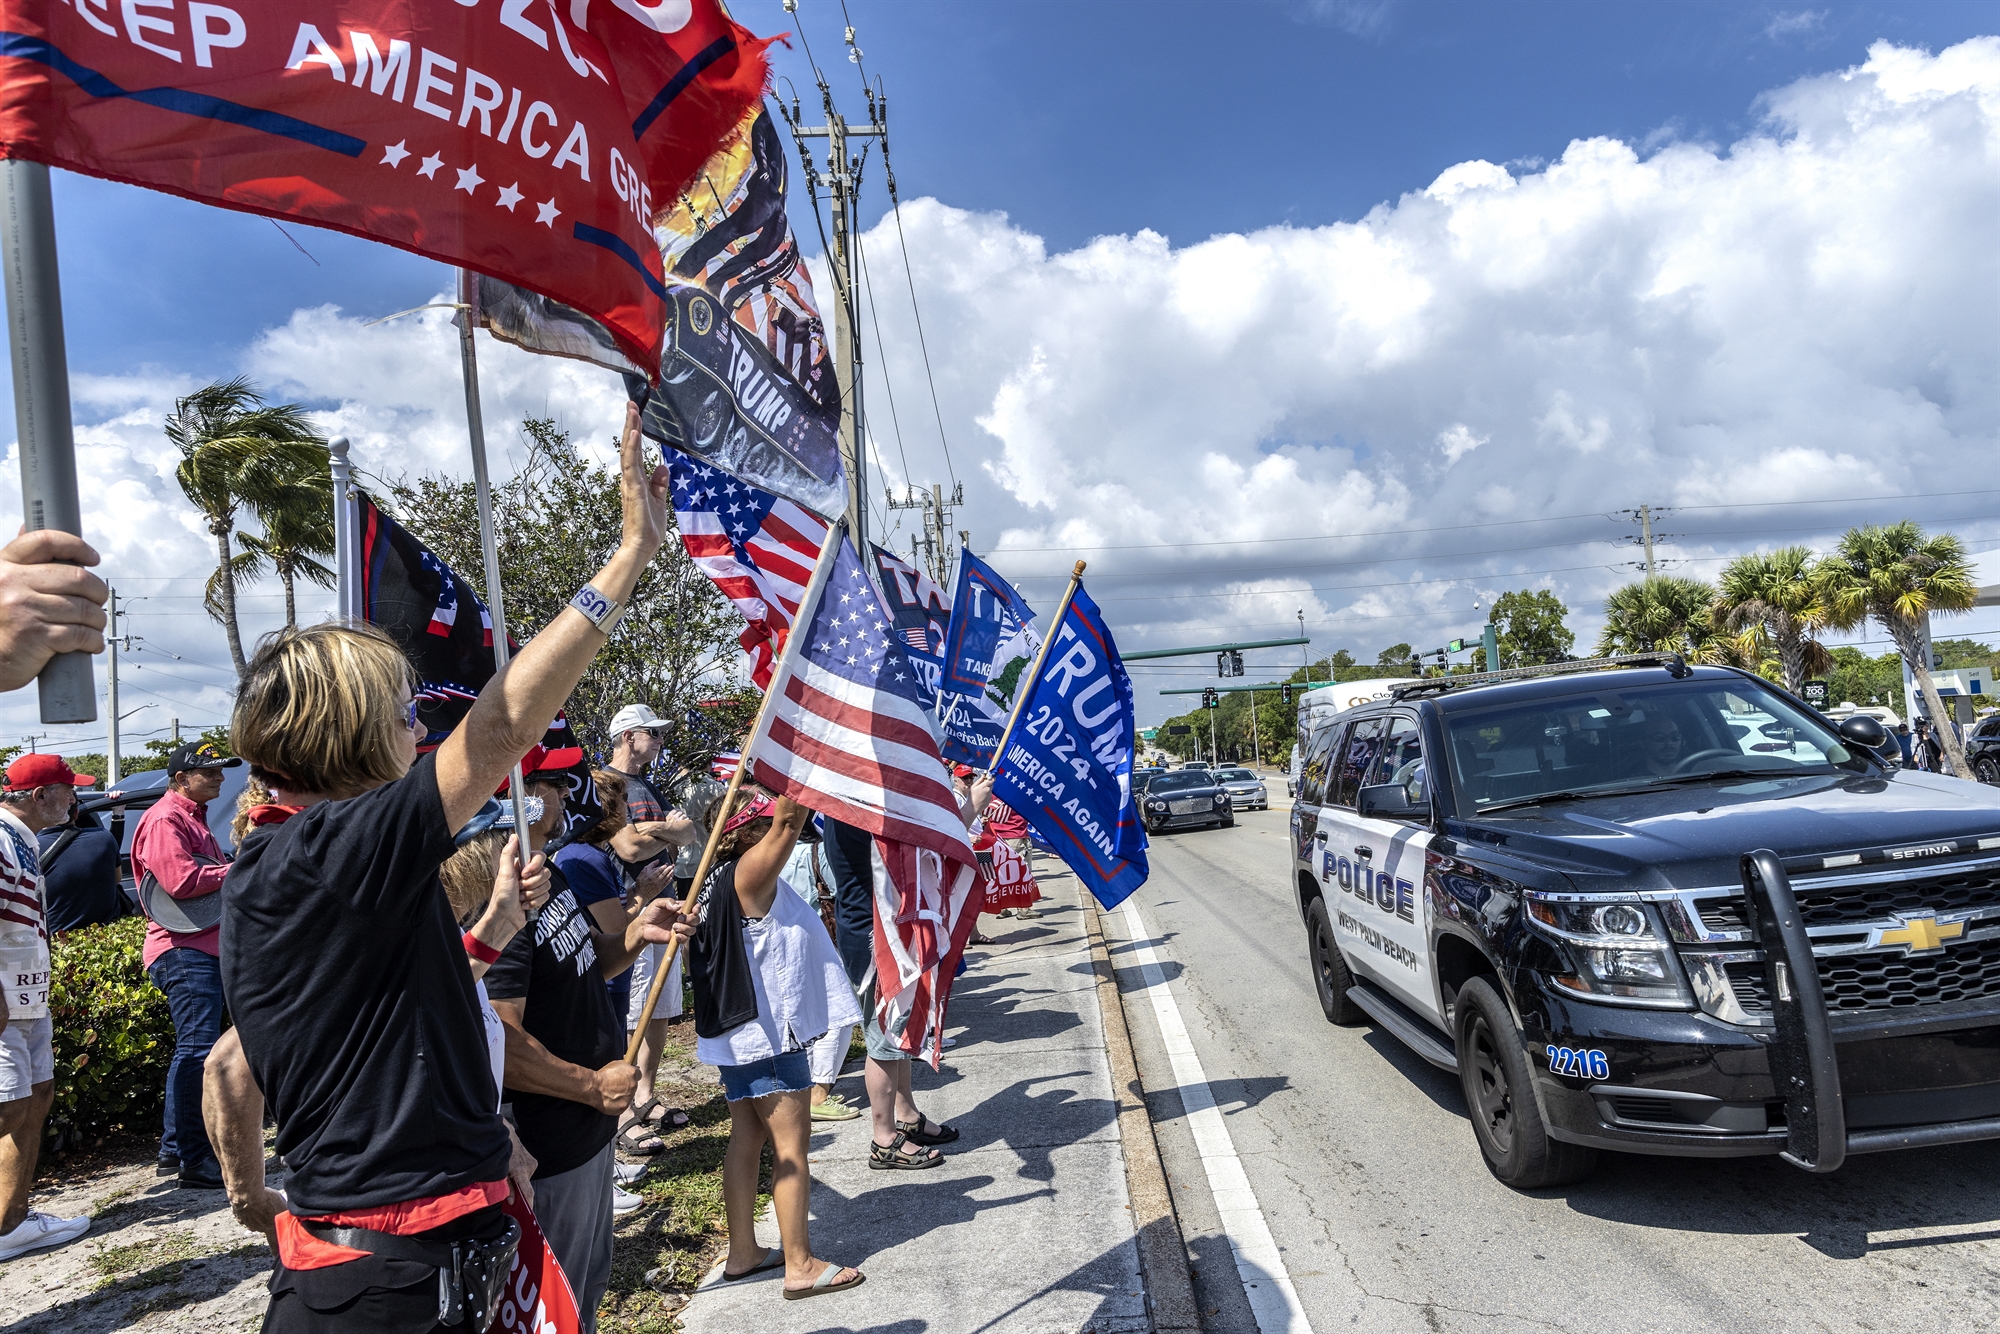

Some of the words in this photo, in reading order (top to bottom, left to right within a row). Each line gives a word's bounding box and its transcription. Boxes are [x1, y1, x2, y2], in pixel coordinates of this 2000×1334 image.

[61, 0, 247, 68] EEP
[285, 22, 592, 183] AMERICA
[610, 147, 656, 242] GRE
[727, 329, 792, 433] TRUMP
[1372, 692, 1394, 700] Clo
[1892, 845, 1952, 860] SETINA
[1322, 849, 1415, 925] POLICE
[549, 929, 577, 962] DID
[1337, 909, 1359, 936] WEST
[1360, 922, 1383, 951] PALM
[1383, 935, 1418, 972] BEACH
[1546, 1044, 1610, 1080] 2216
